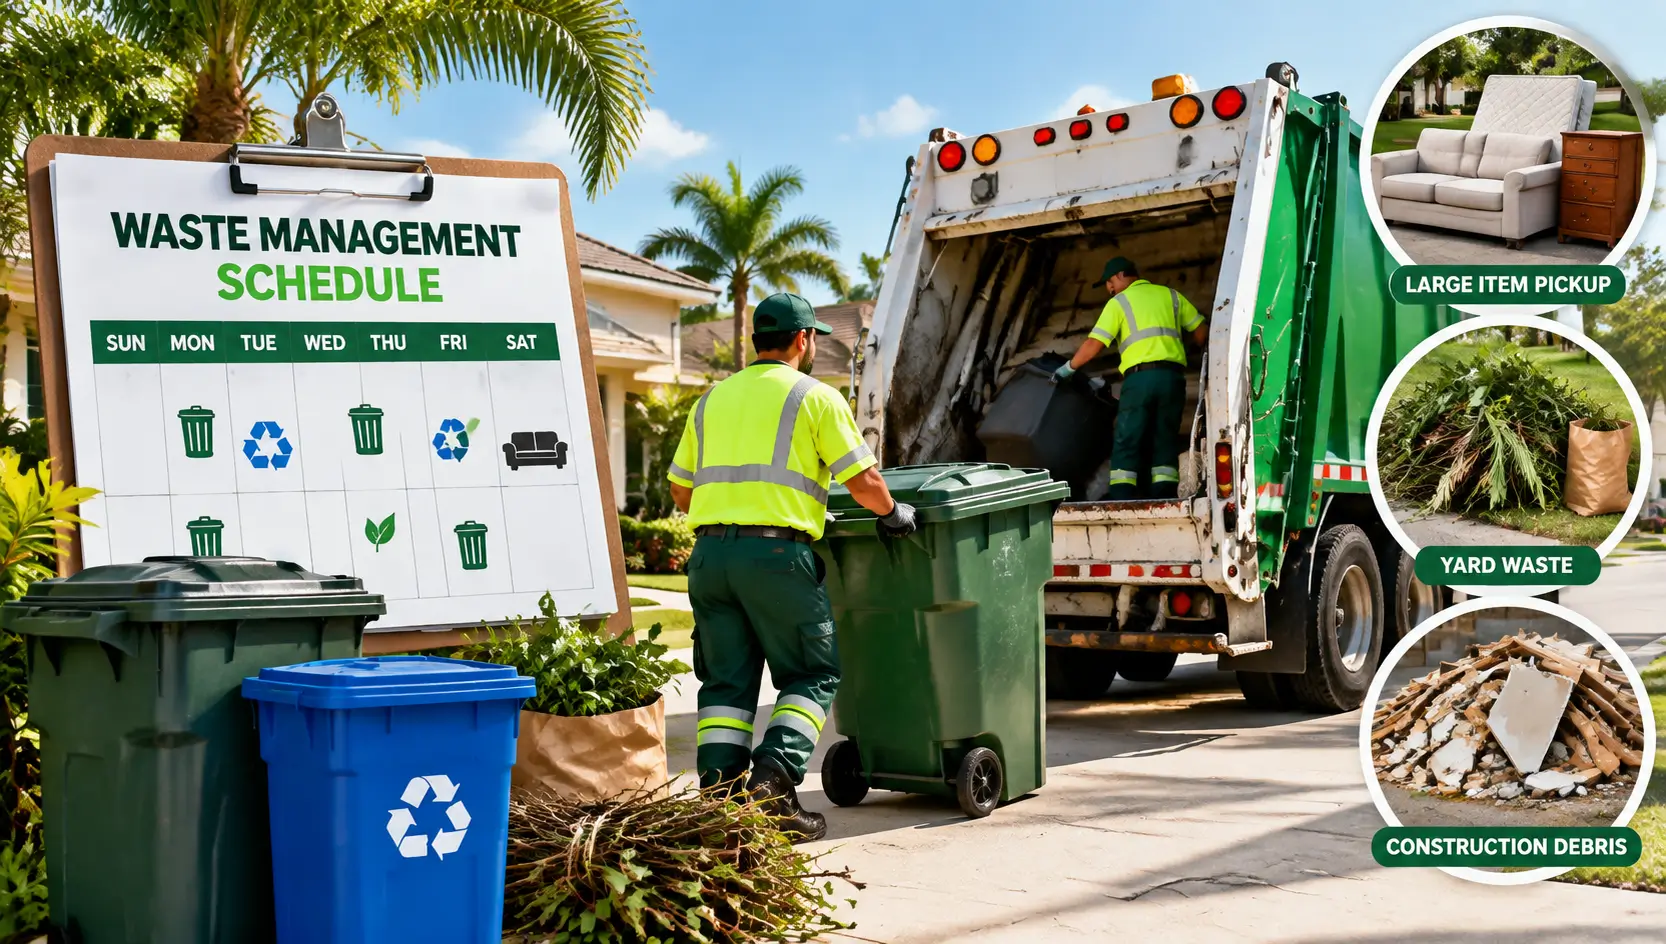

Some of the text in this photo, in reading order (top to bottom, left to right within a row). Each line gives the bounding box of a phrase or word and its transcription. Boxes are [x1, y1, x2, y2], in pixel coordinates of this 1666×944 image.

[110, 211, 521, 258] WASTE MANAGEMENT
[217, 262, 444, 303] SCHEDULE
[106, 334, 537, 352] SUN MON TUE WED THU FRI SAT
